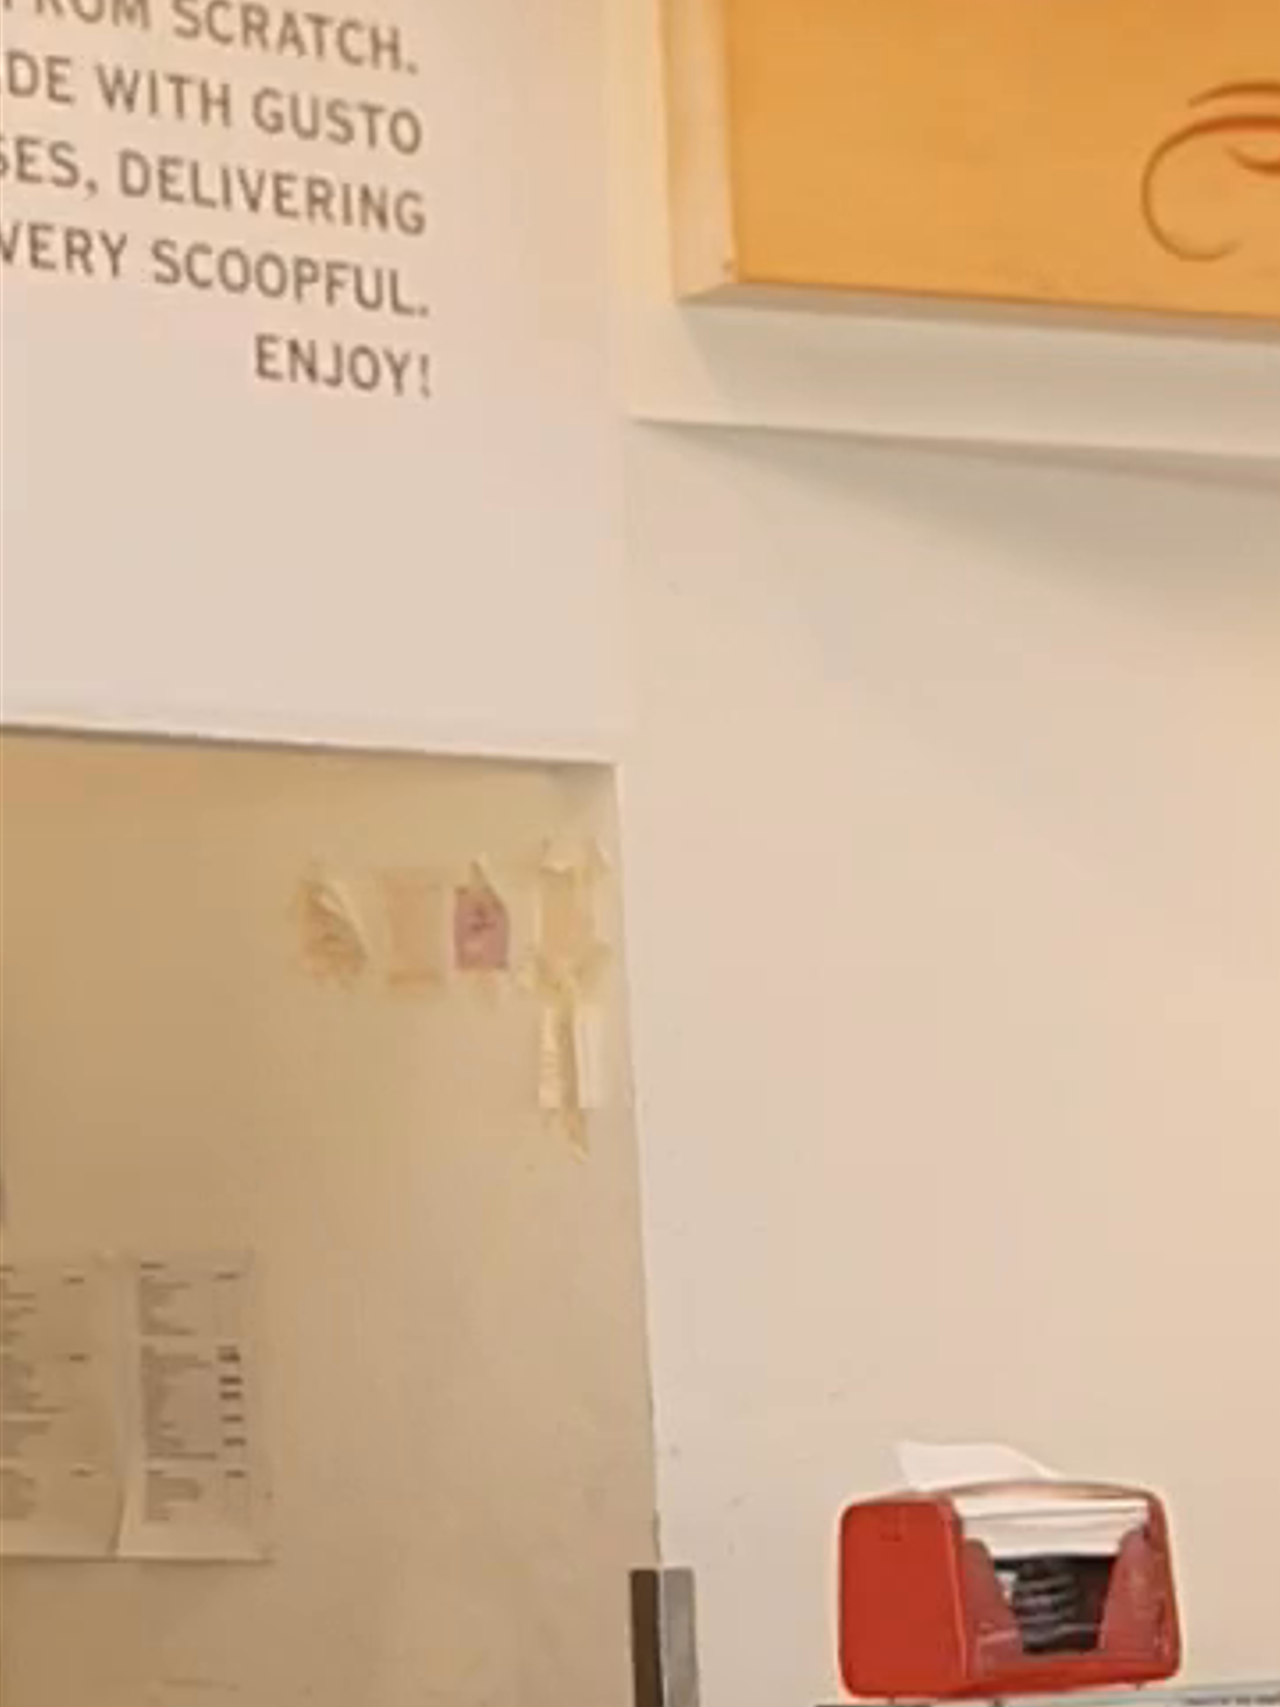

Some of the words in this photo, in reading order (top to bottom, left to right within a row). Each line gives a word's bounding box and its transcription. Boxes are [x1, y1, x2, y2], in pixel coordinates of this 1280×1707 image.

[96, 63, 232, 128] WITH
[252, 88, 423, 156] GUSTO
[118, 149, 427, 237] DELIVERING
[151, 239, 430, 318] SCOOPFUL.
[255, 334, 431, 398] ENJOY!
